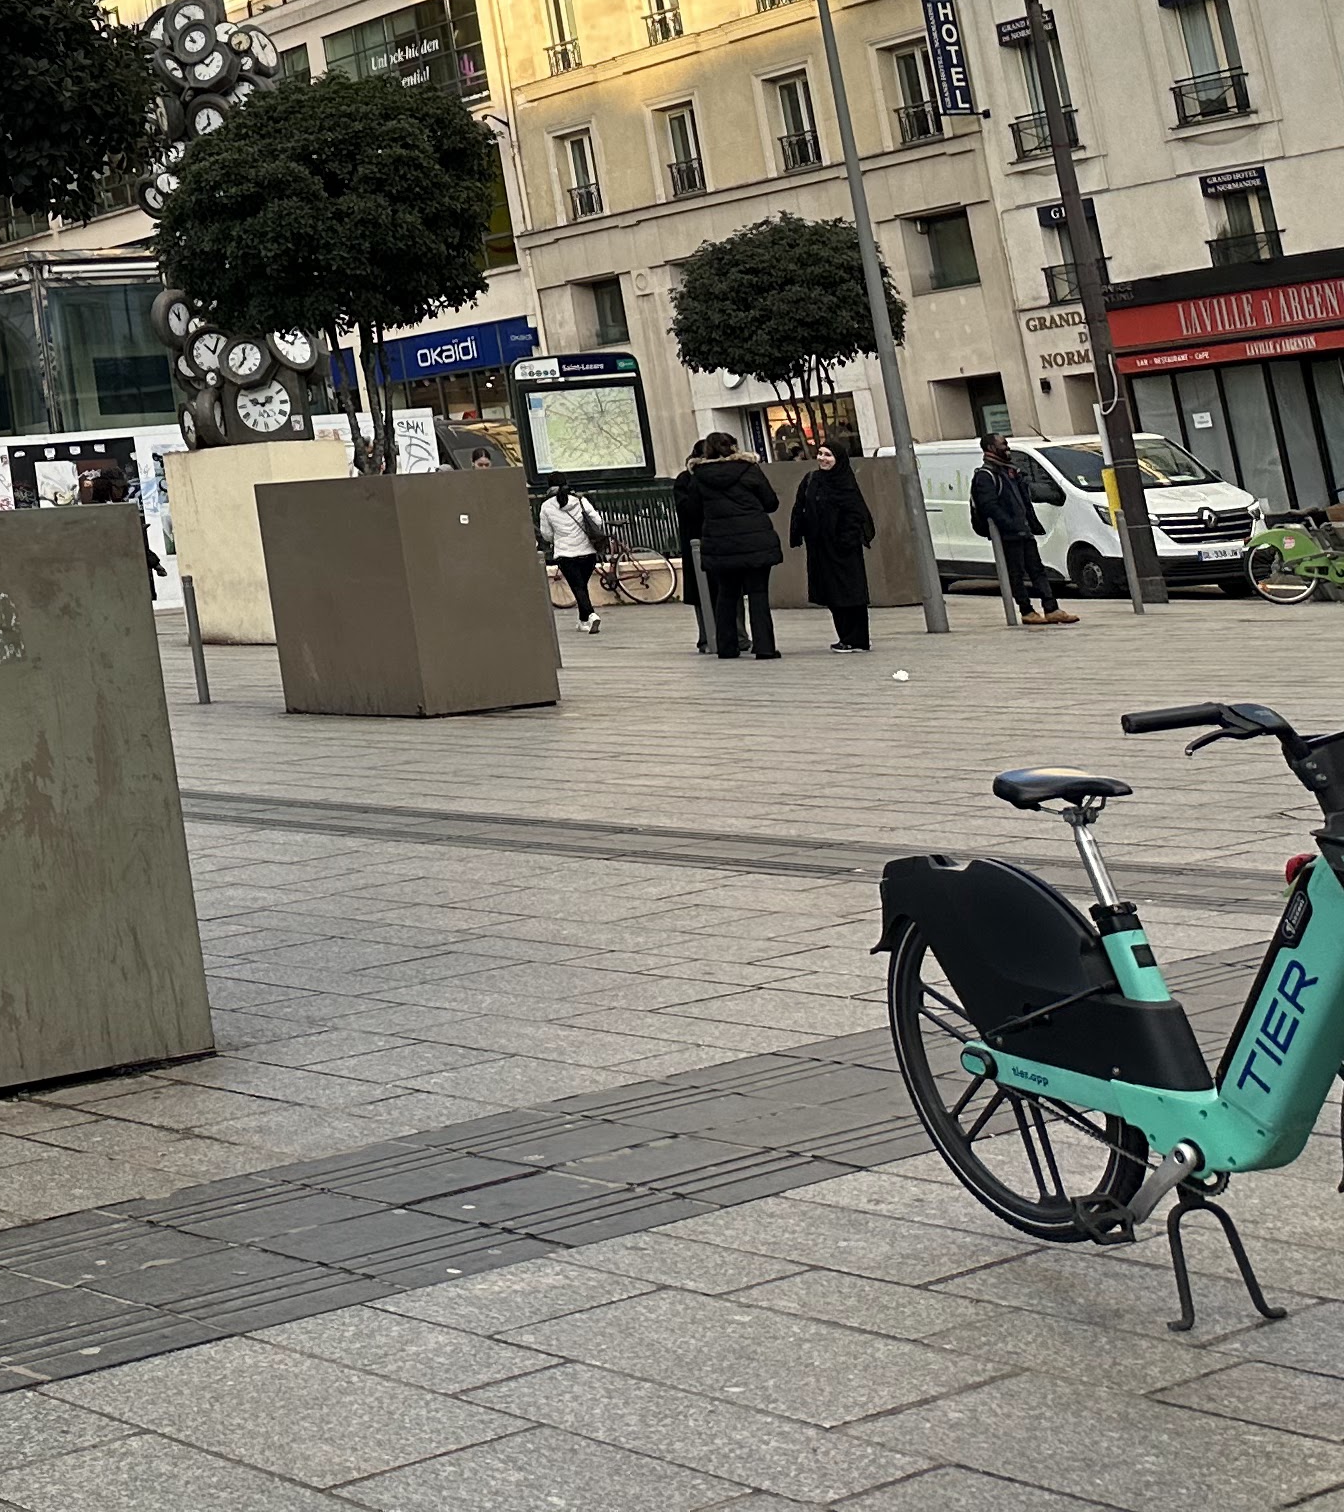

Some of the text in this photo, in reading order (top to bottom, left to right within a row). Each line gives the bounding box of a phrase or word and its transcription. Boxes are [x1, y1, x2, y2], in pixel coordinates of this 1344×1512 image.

[936, 1, 971, 109] HOTEL
[1206, 169, 1259, 184] GRAND HOTEL
[1216, 178, 1262, 192] NORMANDIE
[1025, 310, 1083, 333] GRAND
[1236, 959, 1319, 1094] TIER
